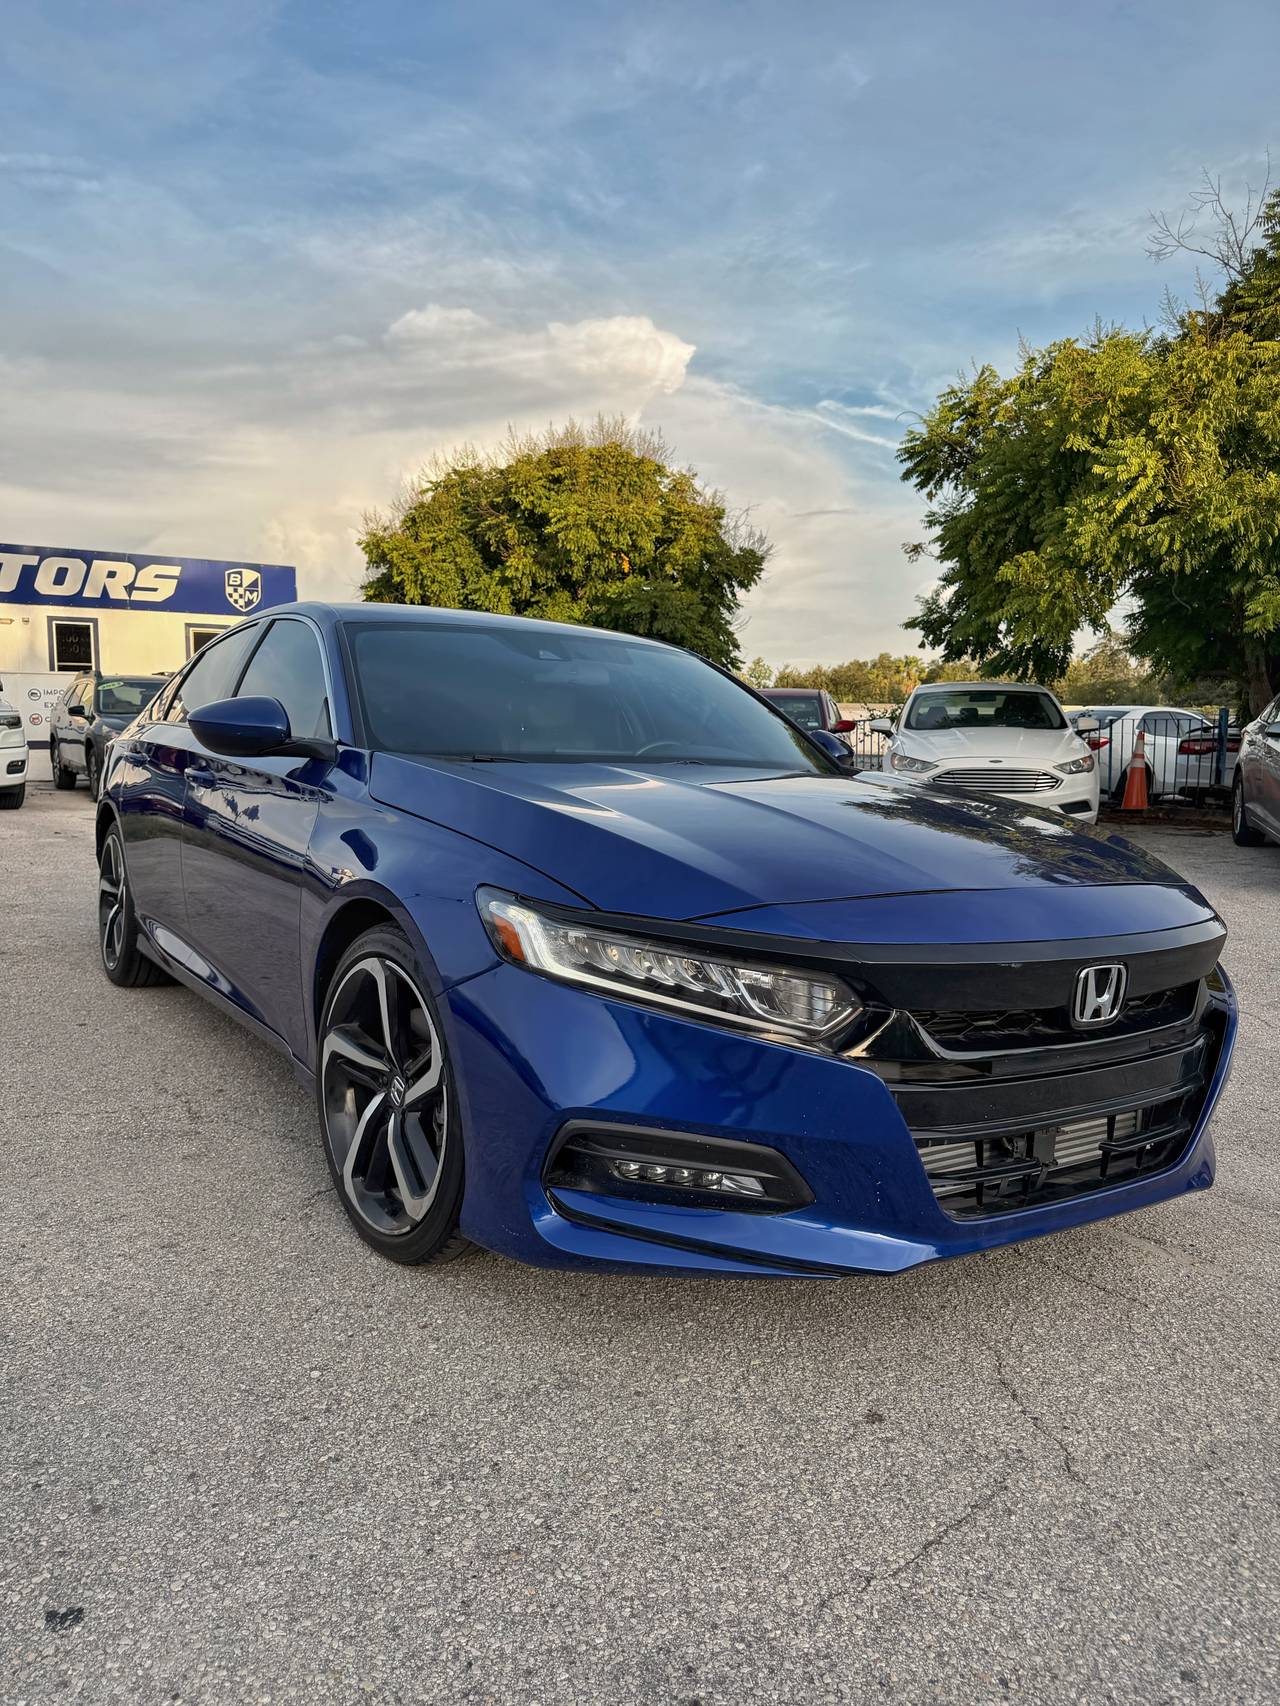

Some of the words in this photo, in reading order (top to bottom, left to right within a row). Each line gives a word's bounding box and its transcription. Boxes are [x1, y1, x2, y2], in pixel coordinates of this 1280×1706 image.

[0, 552, 182, 602] TORS
[228, 573, 242, 585] B
[244, 590, 258, 602] M
